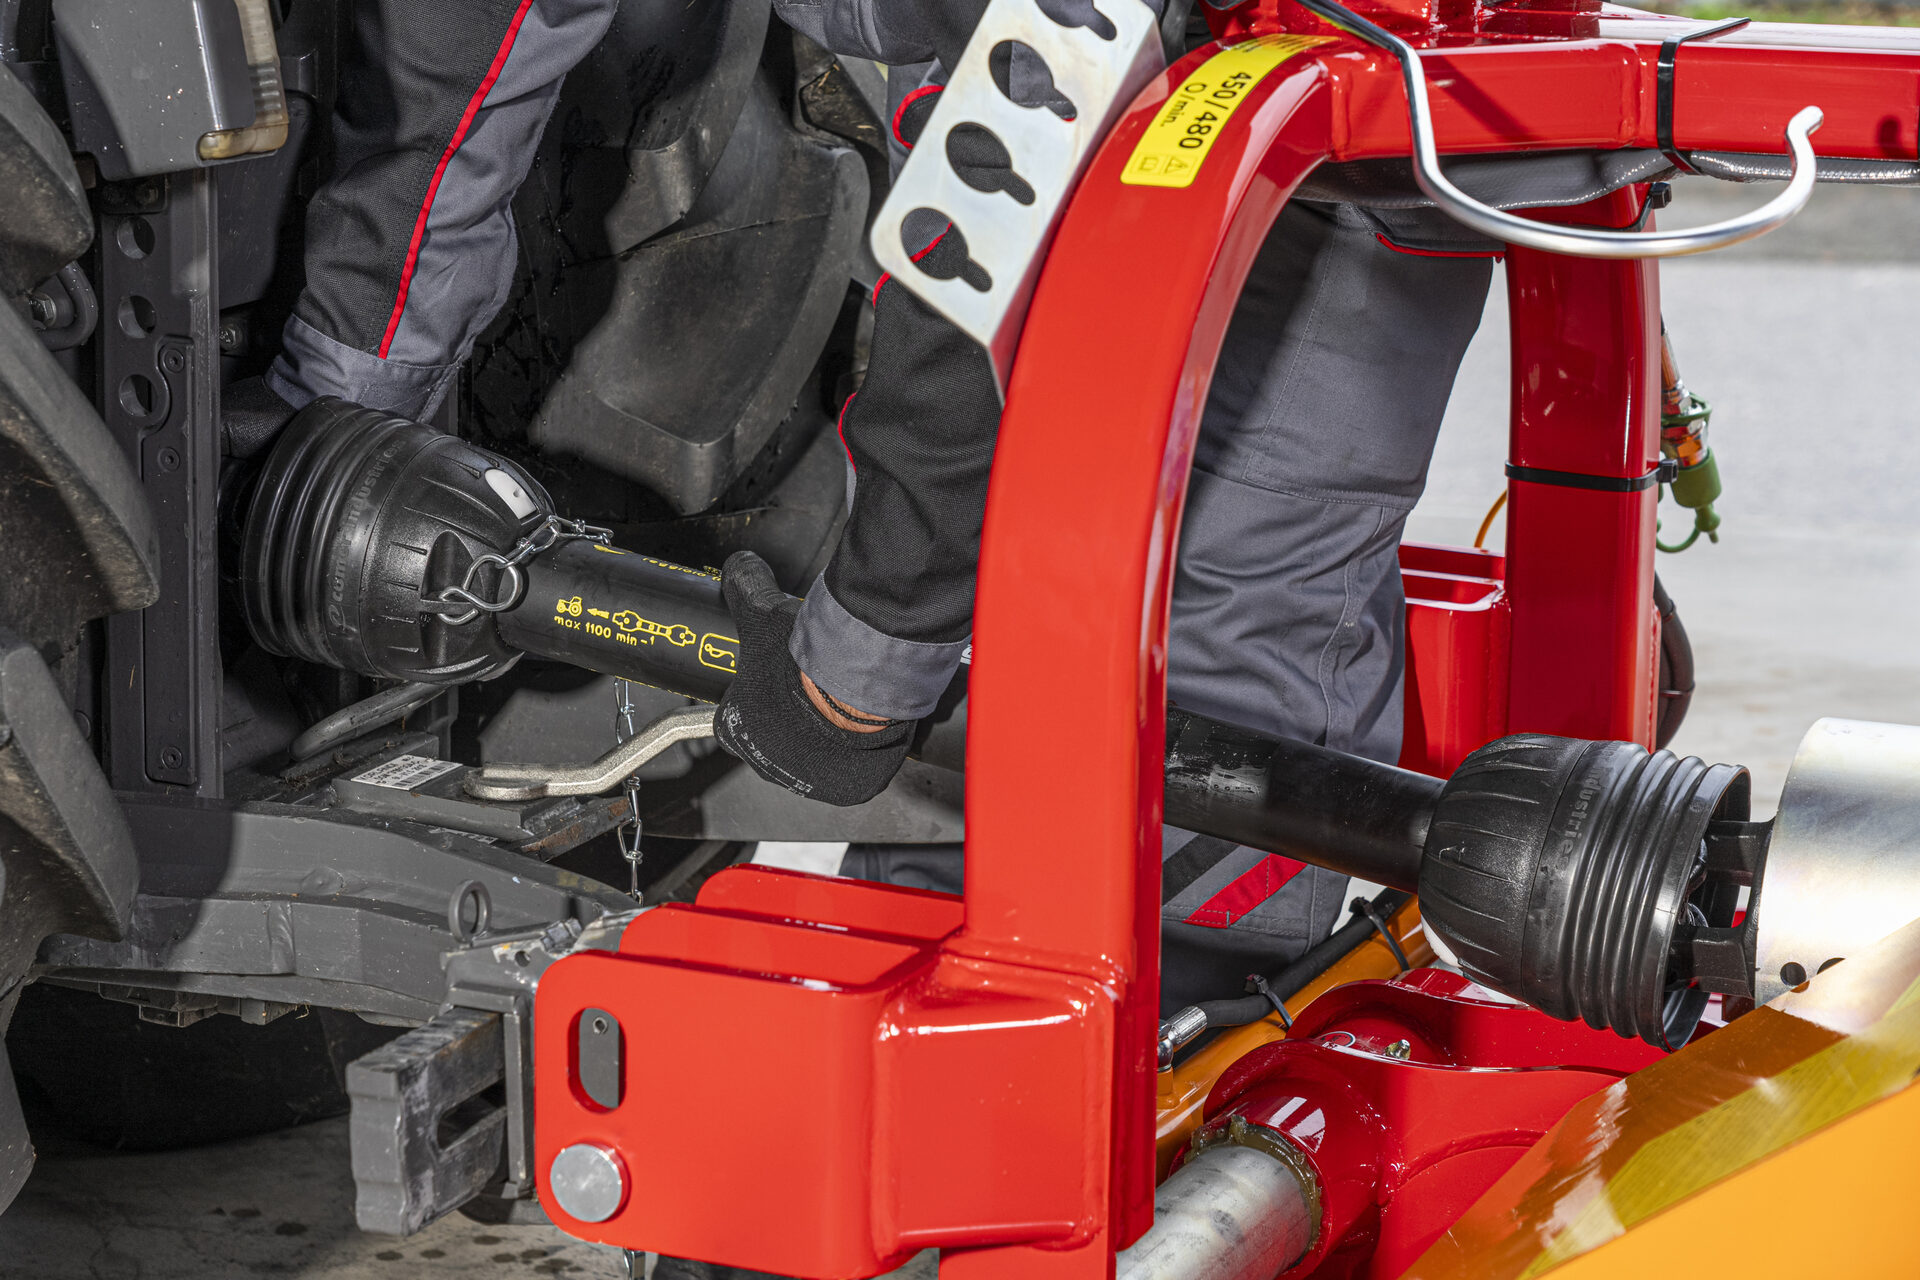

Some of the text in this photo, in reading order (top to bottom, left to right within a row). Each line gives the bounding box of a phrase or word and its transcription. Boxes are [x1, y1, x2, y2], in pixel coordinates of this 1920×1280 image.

[345, 440, 404, 530] industries
[554, 615, 581, 630] max
[585, 622, 612, 639] 1100
